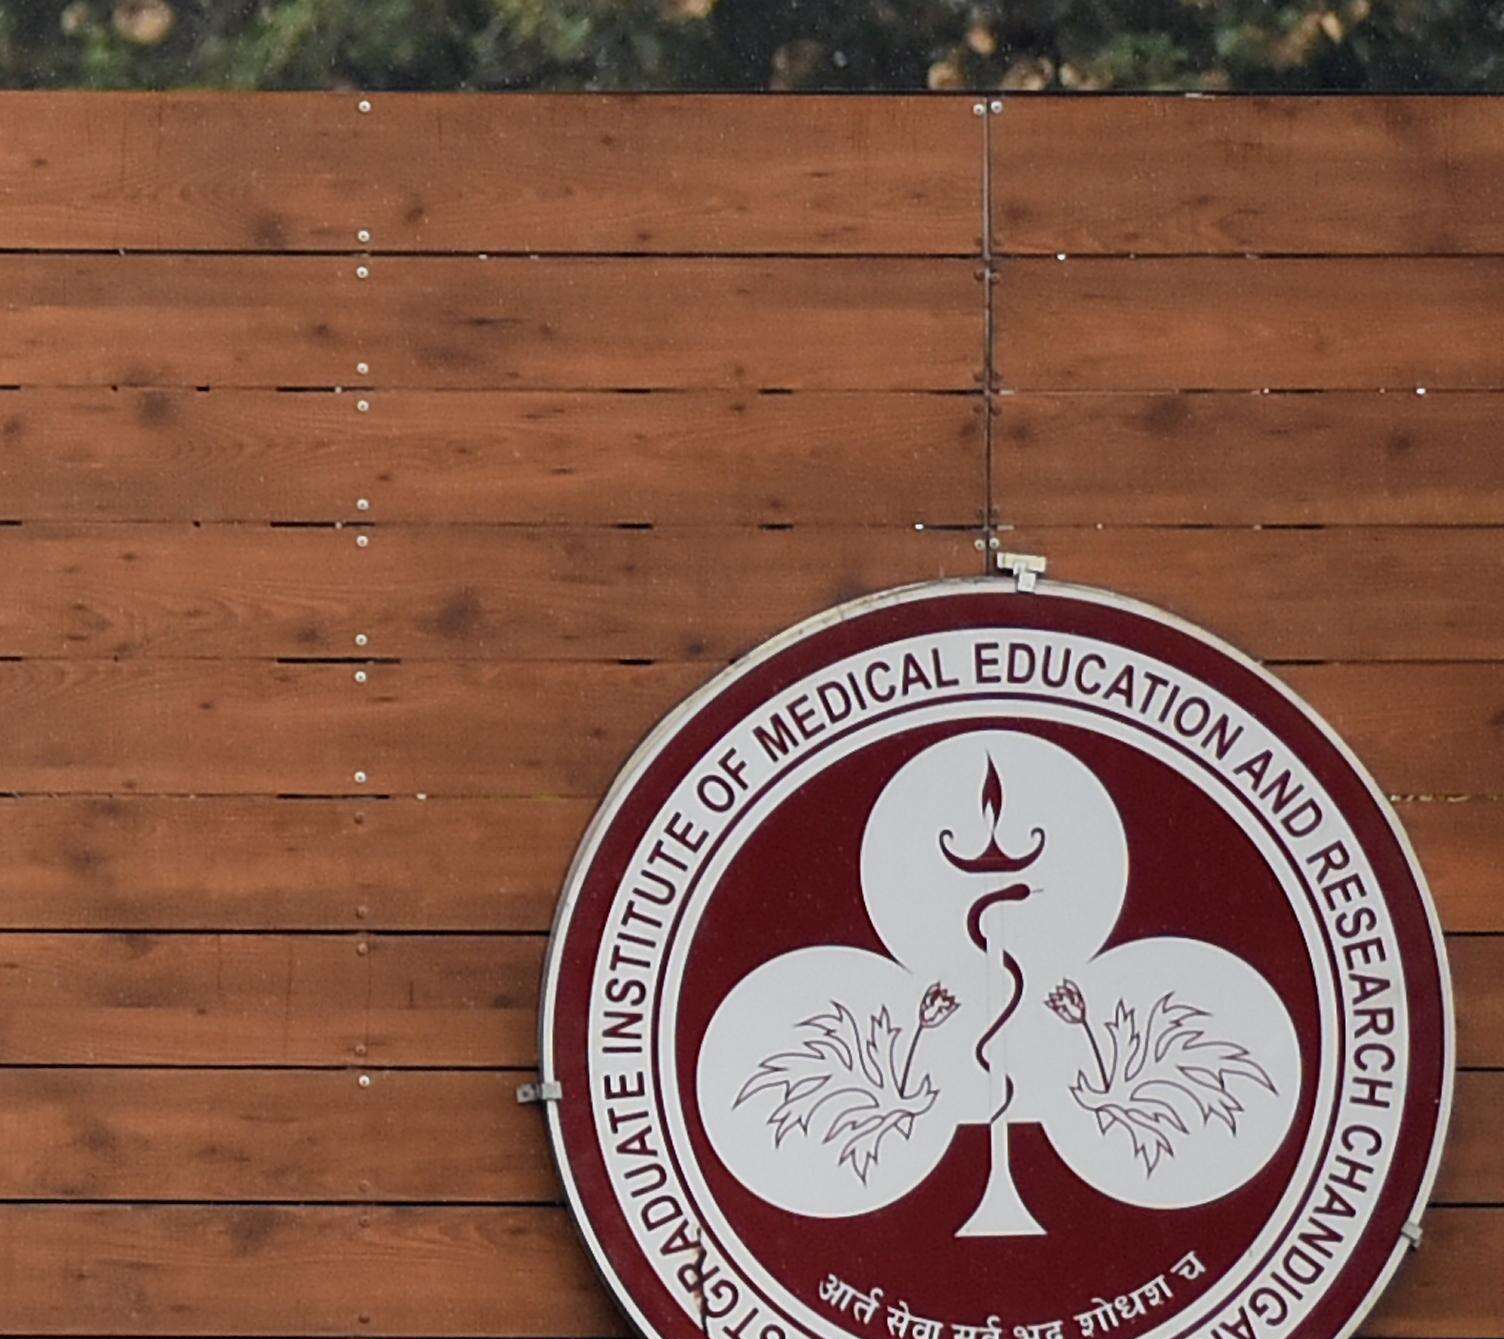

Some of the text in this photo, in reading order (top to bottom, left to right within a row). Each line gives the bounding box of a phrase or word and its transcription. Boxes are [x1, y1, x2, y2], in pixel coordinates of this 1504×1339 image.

[601, 811, 710, 1056] INSTITUTE
[696, 747, 749, 813] OF
[752, 647, 960, 763] MEDICAL
[974, 642, 1244, 761] EDUCATION
[1233, 749, 1323, 838] AND
[1305, 839, 1396, 1109] RESEARCH
[819, 1273, 883, 1325] आर्त
[1170, 1250, 1206, 1281] च
